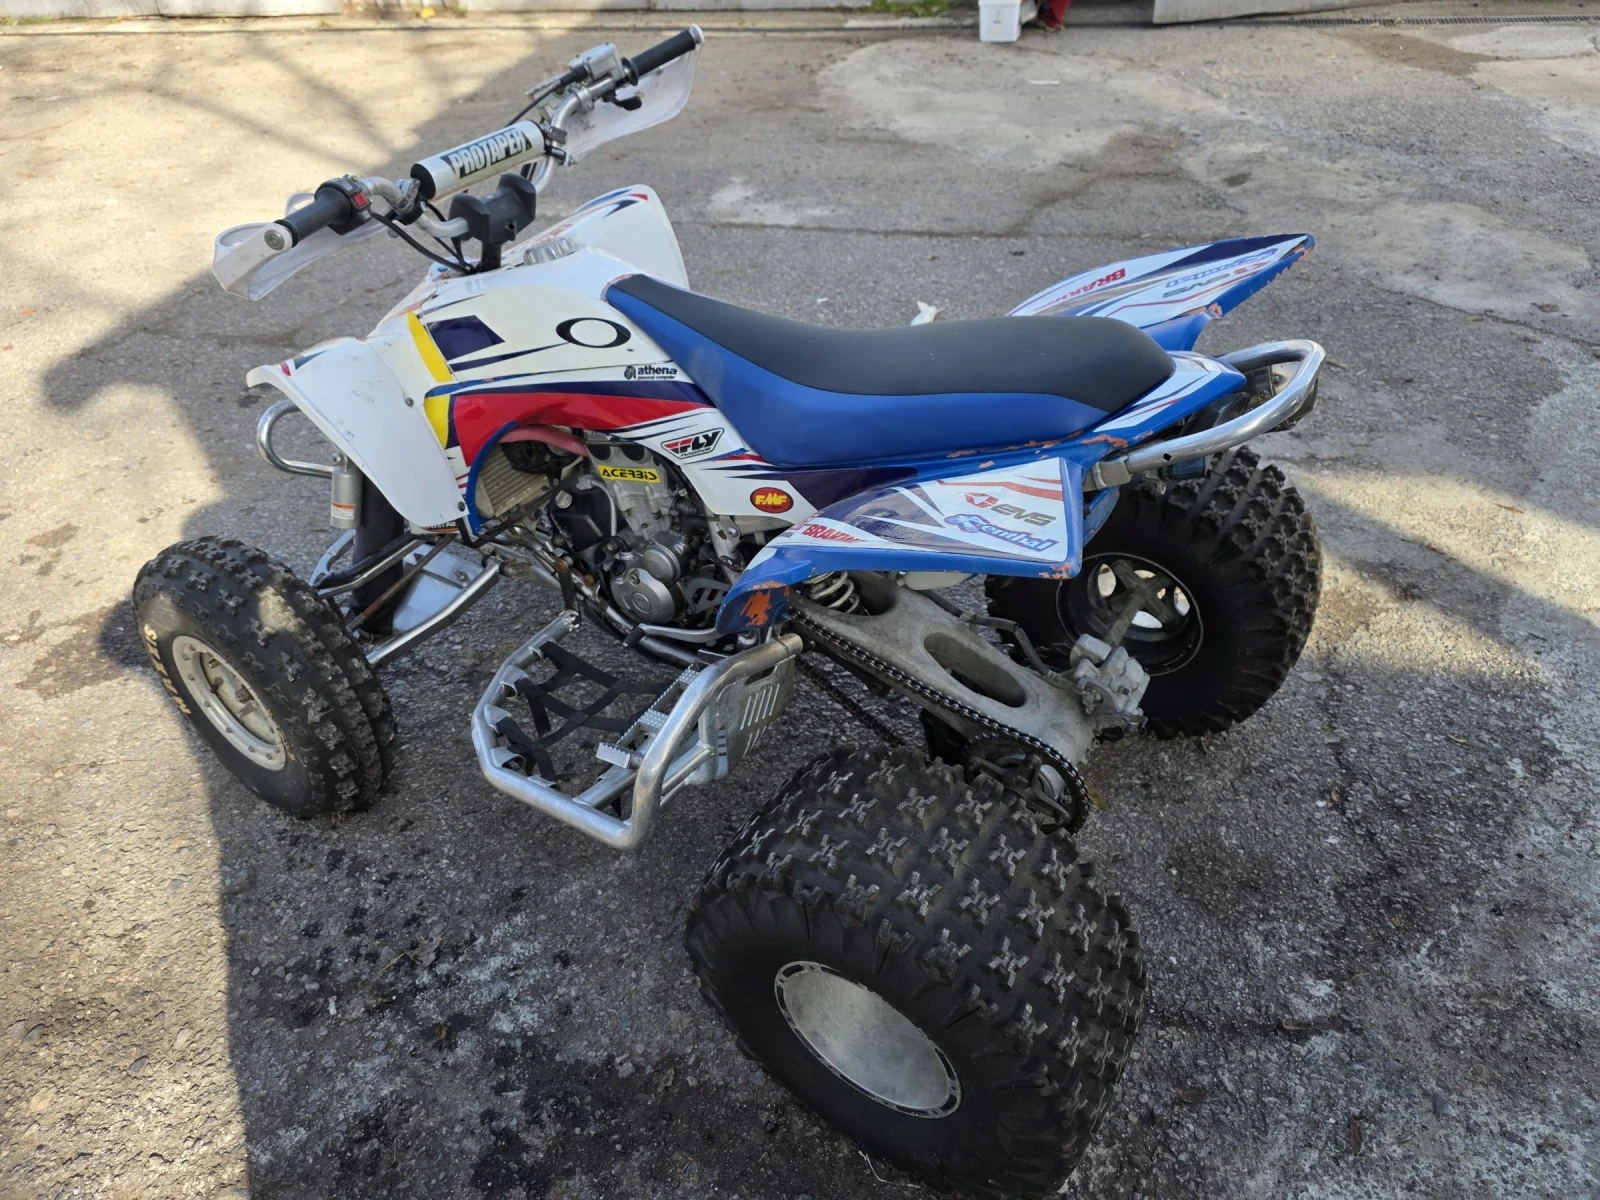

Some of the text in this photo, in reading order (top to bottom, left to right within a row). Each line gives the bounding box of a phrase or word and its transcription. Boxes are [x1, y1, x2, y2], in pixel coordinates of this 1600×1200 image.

[448, 130, 527, 177] PROTAPER
[637, 364, 678, 375] athena
[663, 431, 721, 454] FLY
[755, 492, 788, 506] FMF
[990, 503, 1057, 526] EVS
